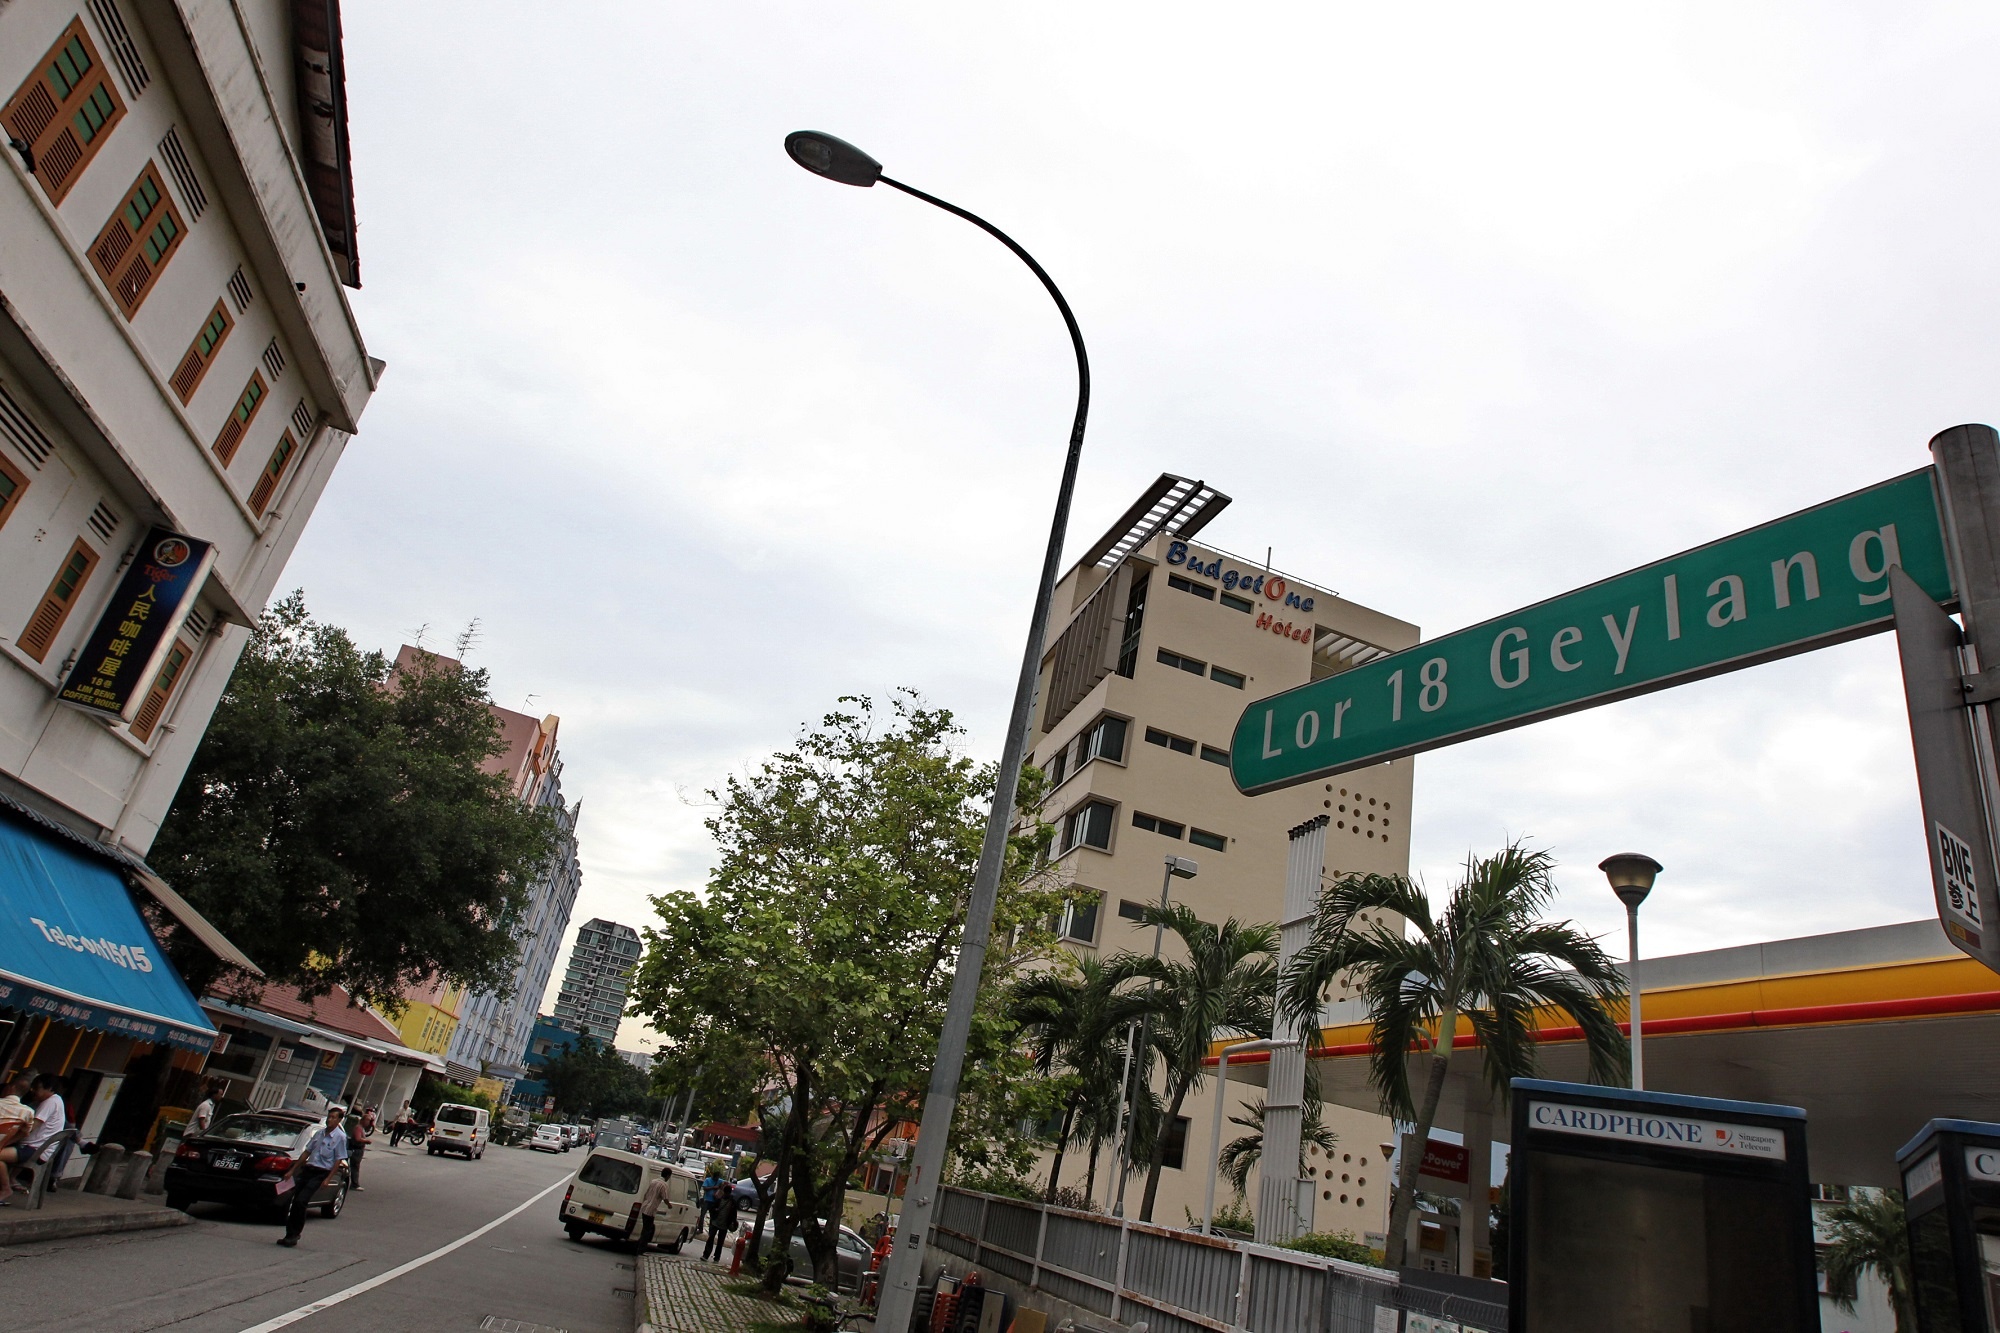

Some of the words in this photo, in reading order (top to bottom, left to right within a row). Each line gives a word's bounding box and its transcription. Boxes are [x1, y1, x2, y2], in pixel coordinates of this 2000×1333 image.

[143, 564, 177, 583] Tiger
[1166, 541, 1314, 612] BudgetOne
[97, 584, 156, 677] 人民咖啡屋
[1256, 612, 1312, 643] Hotel
[1261, 696, 1352, 760] Lor
[1386, 656, 1449, 722] 18
[1490, 522, 1899, 689] Geylang
[63, 689, 93, 703] COFFEE
[94, 698, 122, 710] HOUSE
[77, 684, 92, 694] LIM
[93, 688, 116, 700] BENG
[1939, 828, 1975, 893] BNE
[1947, 879, 1980, 924] 参上
[278, 1050, 288, 1060] 5
[325, 1052, 336, 1063] 7
[1535, 1106, 1702, 1143] CARDPHONE
[1738, 1132, 1777, 1145] Singapore
[1739, 1141, 1771, 1152] Telecom
[1424, 1152, 1461, 1170] -Power
